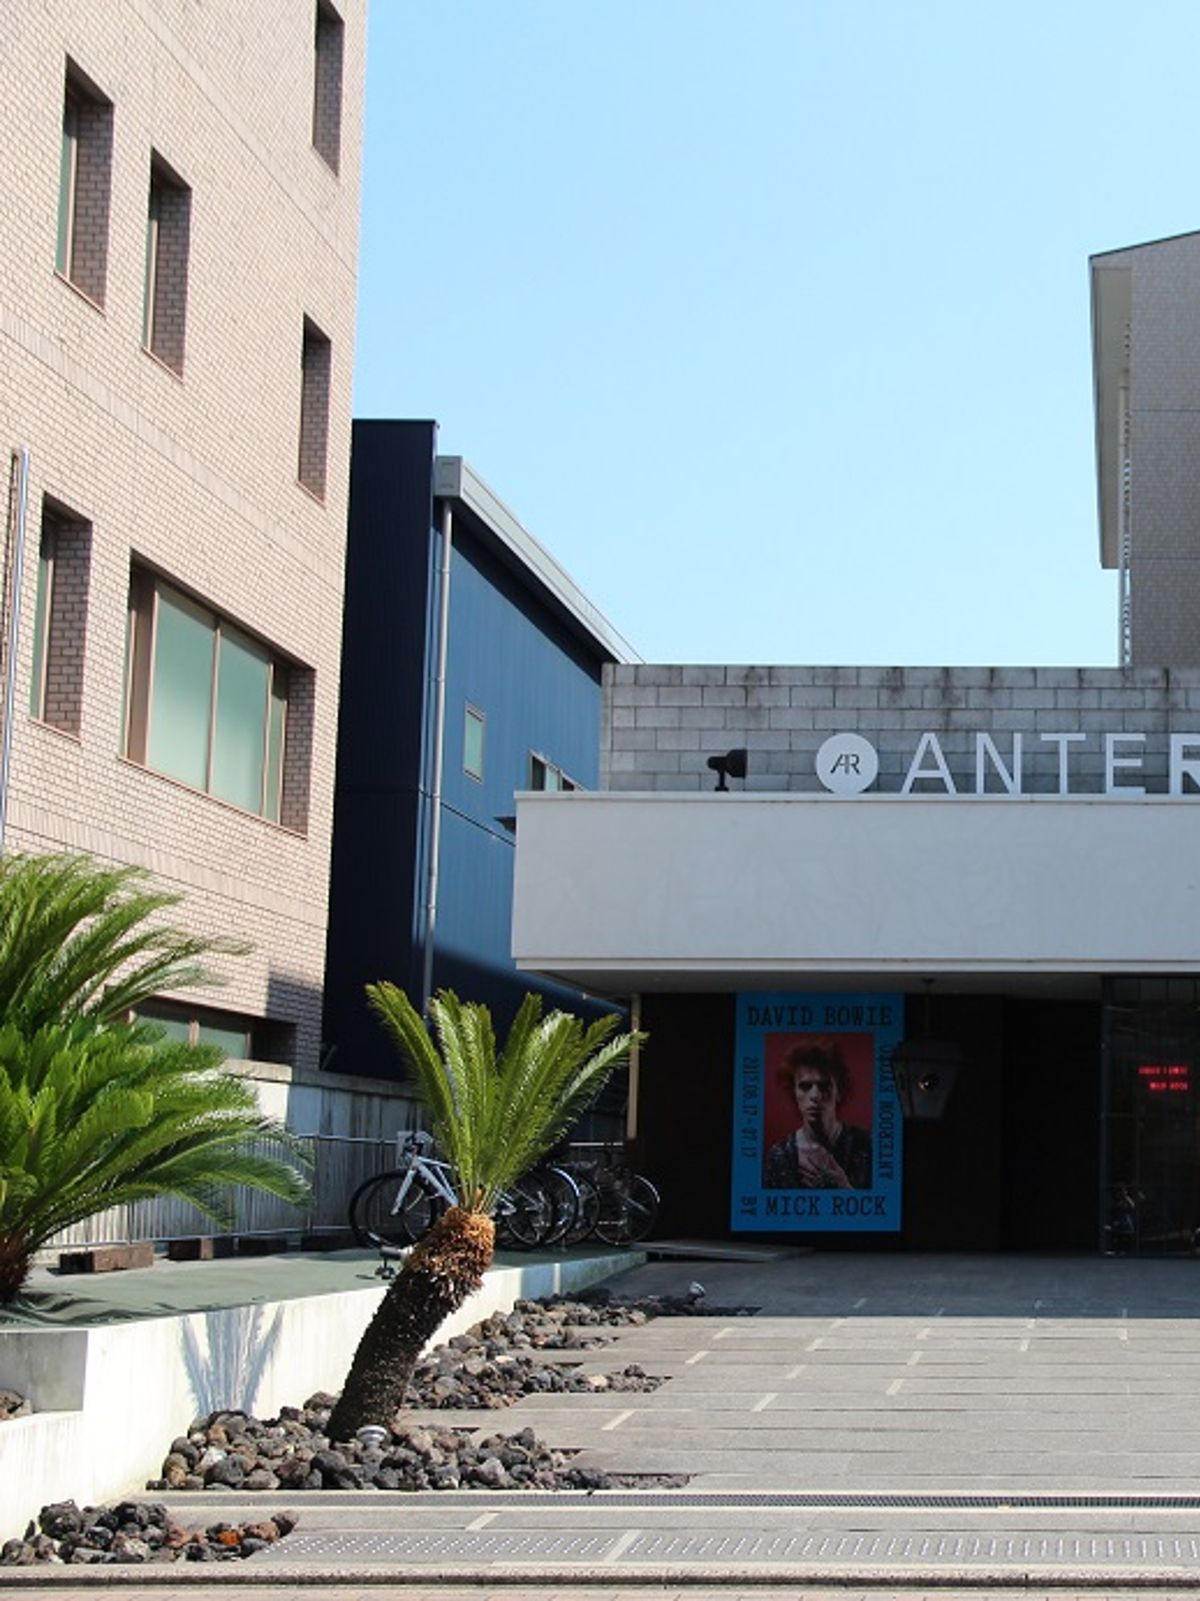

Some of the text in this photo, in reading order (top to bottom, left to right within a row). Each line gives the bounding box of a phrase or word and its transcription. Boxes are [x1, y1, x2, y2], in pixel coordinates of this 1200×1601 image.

[747, 1005, 892, 1026] DAVID BOWIE
[878, 1100, 895, 1180] ANTEROOM
[741, 1196, 758, 1216] BY
[766, 1196, 886, 1216] MICK ROCK
